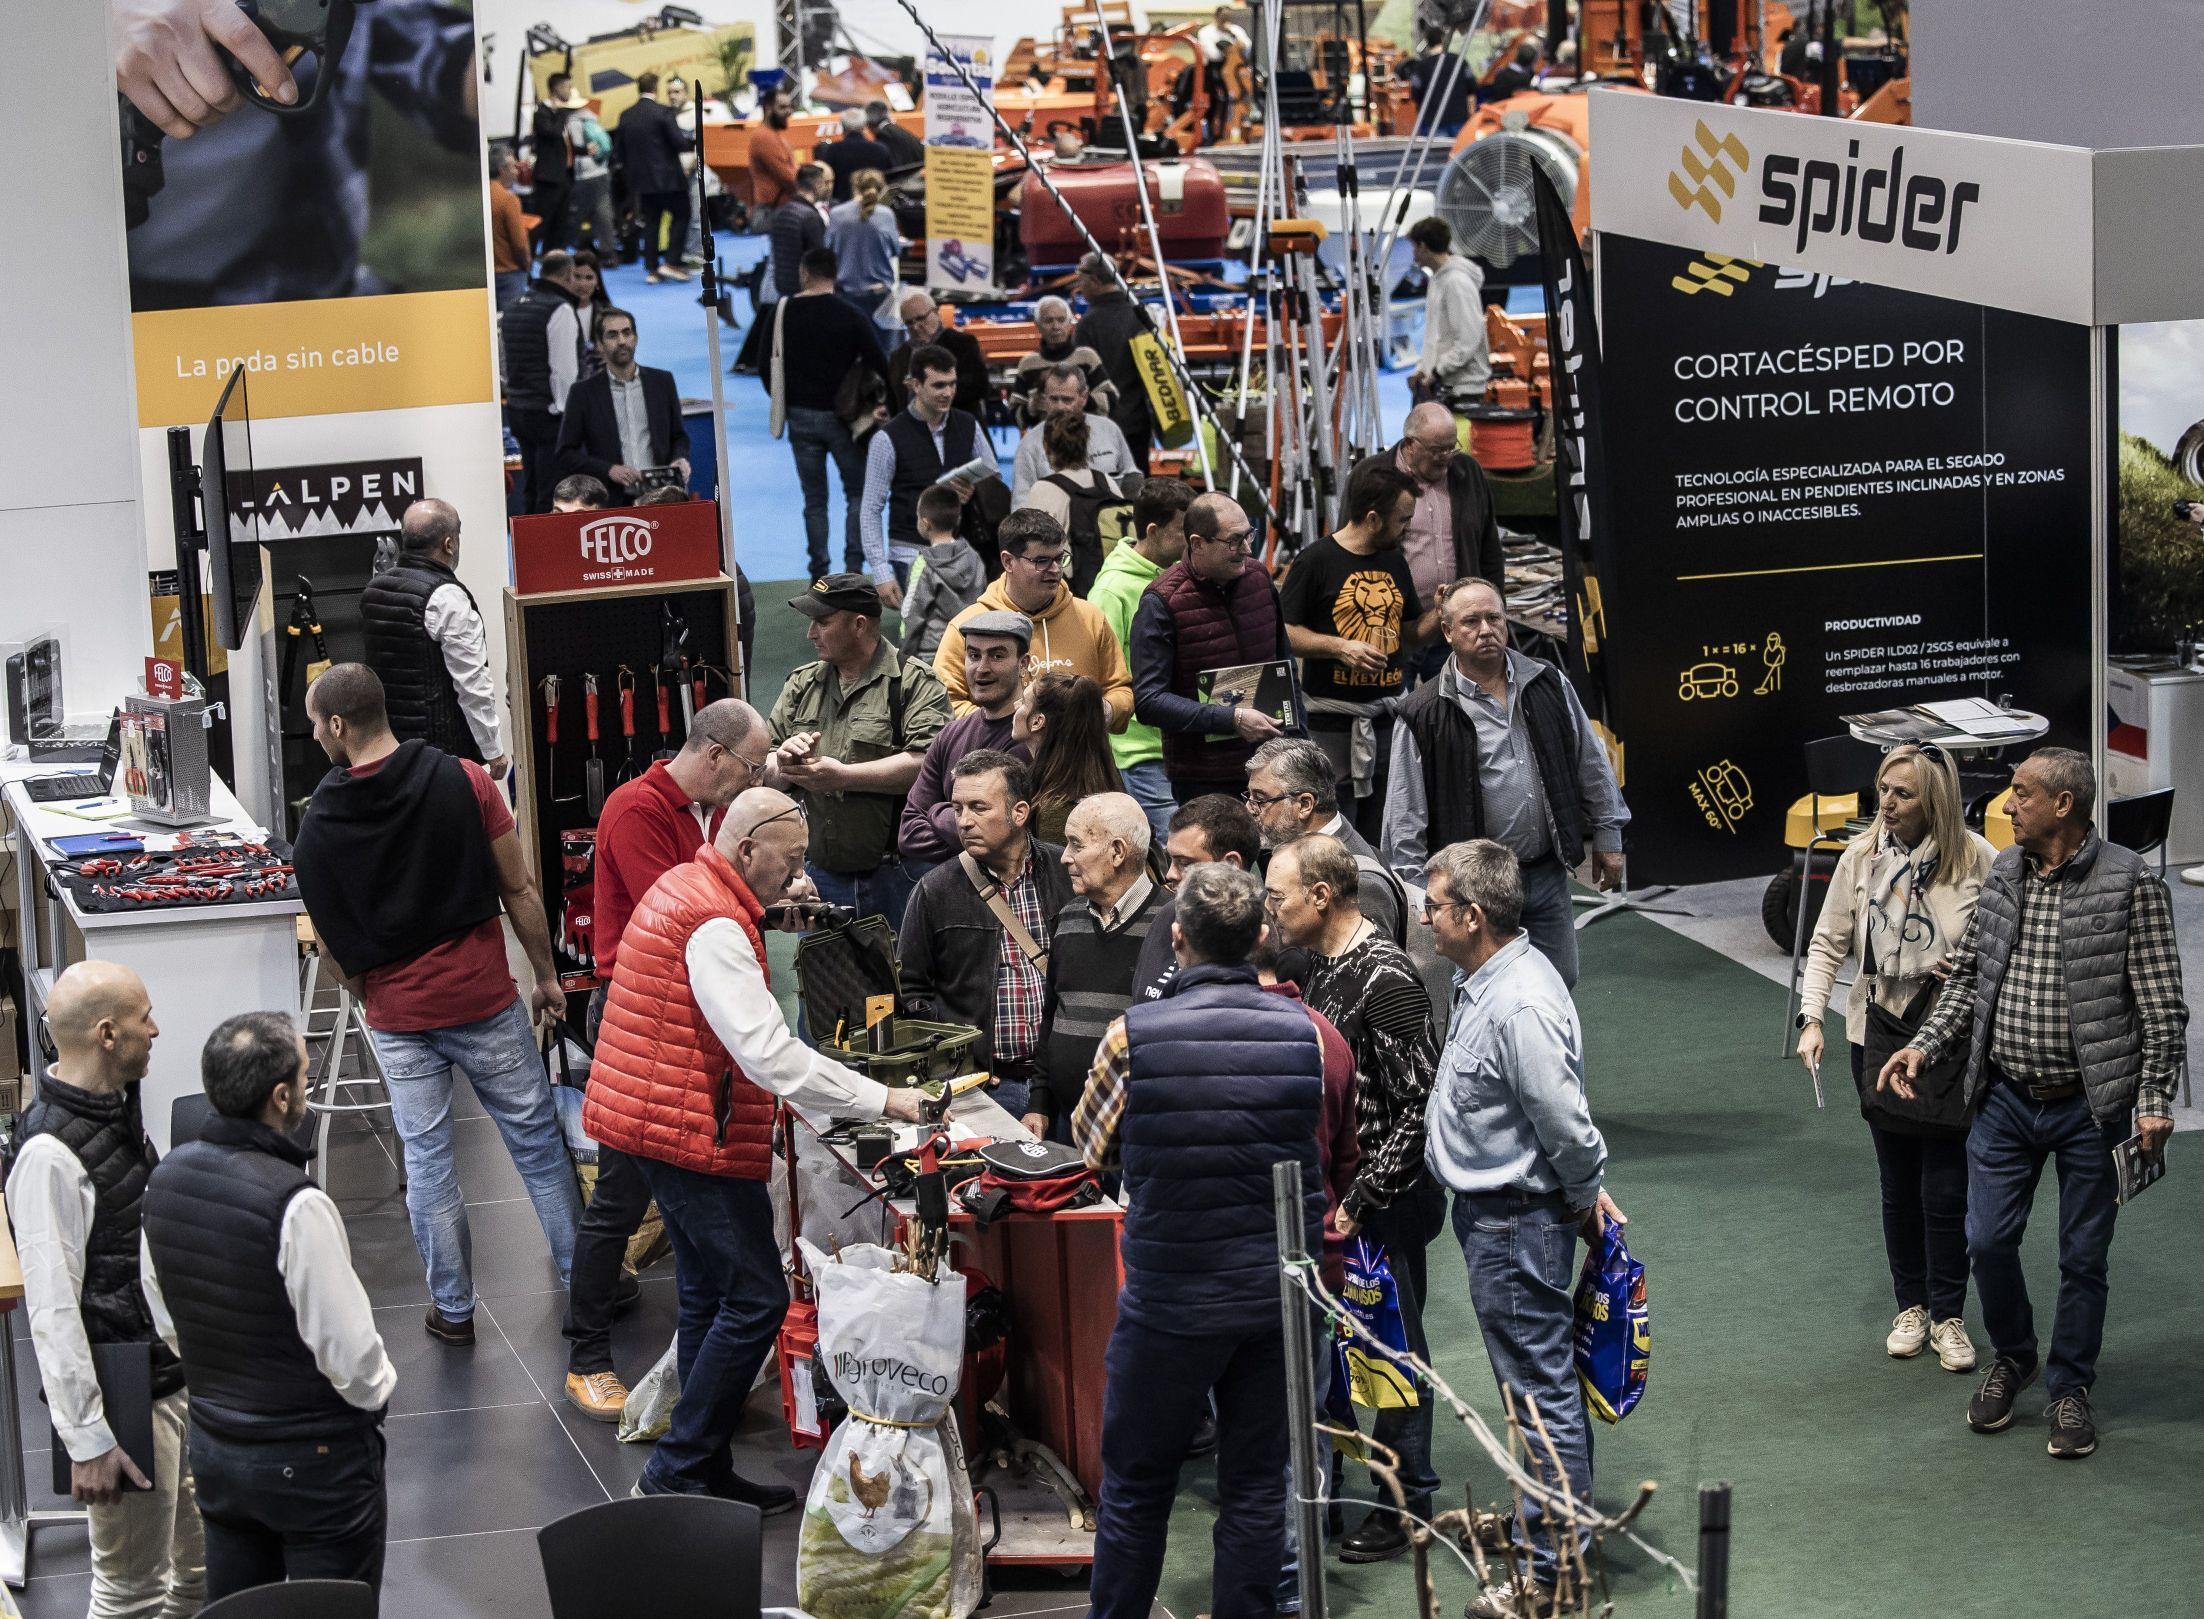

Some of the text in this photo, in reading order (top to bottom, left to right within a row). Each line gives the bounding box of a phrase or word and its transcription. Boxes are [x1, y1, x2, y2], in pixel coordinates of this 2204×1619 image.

[1759, 139, 1980, 254] spider
[176, 341, 399, 380] La poda sin cable
[1674, 339, 1964, 380] CORTACÉSPED POR
[1675, 382, 1954, 423] CONTROL REMOTO
[1675, 453, 2005, 488] TECNOLOGÍA ESPECIALIZADA PARA EL SEGADO
[1676, 468, 2065, 508] PROFESIONAL EN PENDIENTES INCLINADAS Y EN ZONAS
[1676, 503, 1861, 529] AMPLIAS O INACCESIBLES.
[583, 568, 654, 581] SWISS MADE
[1825, 614, 1922, 632] PRODUCTIVIDAD
[1703, 645, 1709, 657] 1
[1733, 643, 1746, 655] 16
[1825, 651, 1842, 662] Un
[1843, 647, 1885, 660] SPIDER
[1956, 637, 2000, 653] equivale
[2002, 639, 2009, 647] a
[1333, 669, 1347, 684] EL
[1825, 652, 2020, 678] reemplazar hasta 16 trabajadores con
[1825, 669, 2004, 693] desbrozadoras manuales a motor.
[1688, 782, 1710, 811] MAX
[576, 916, 591, 926] FELCO
